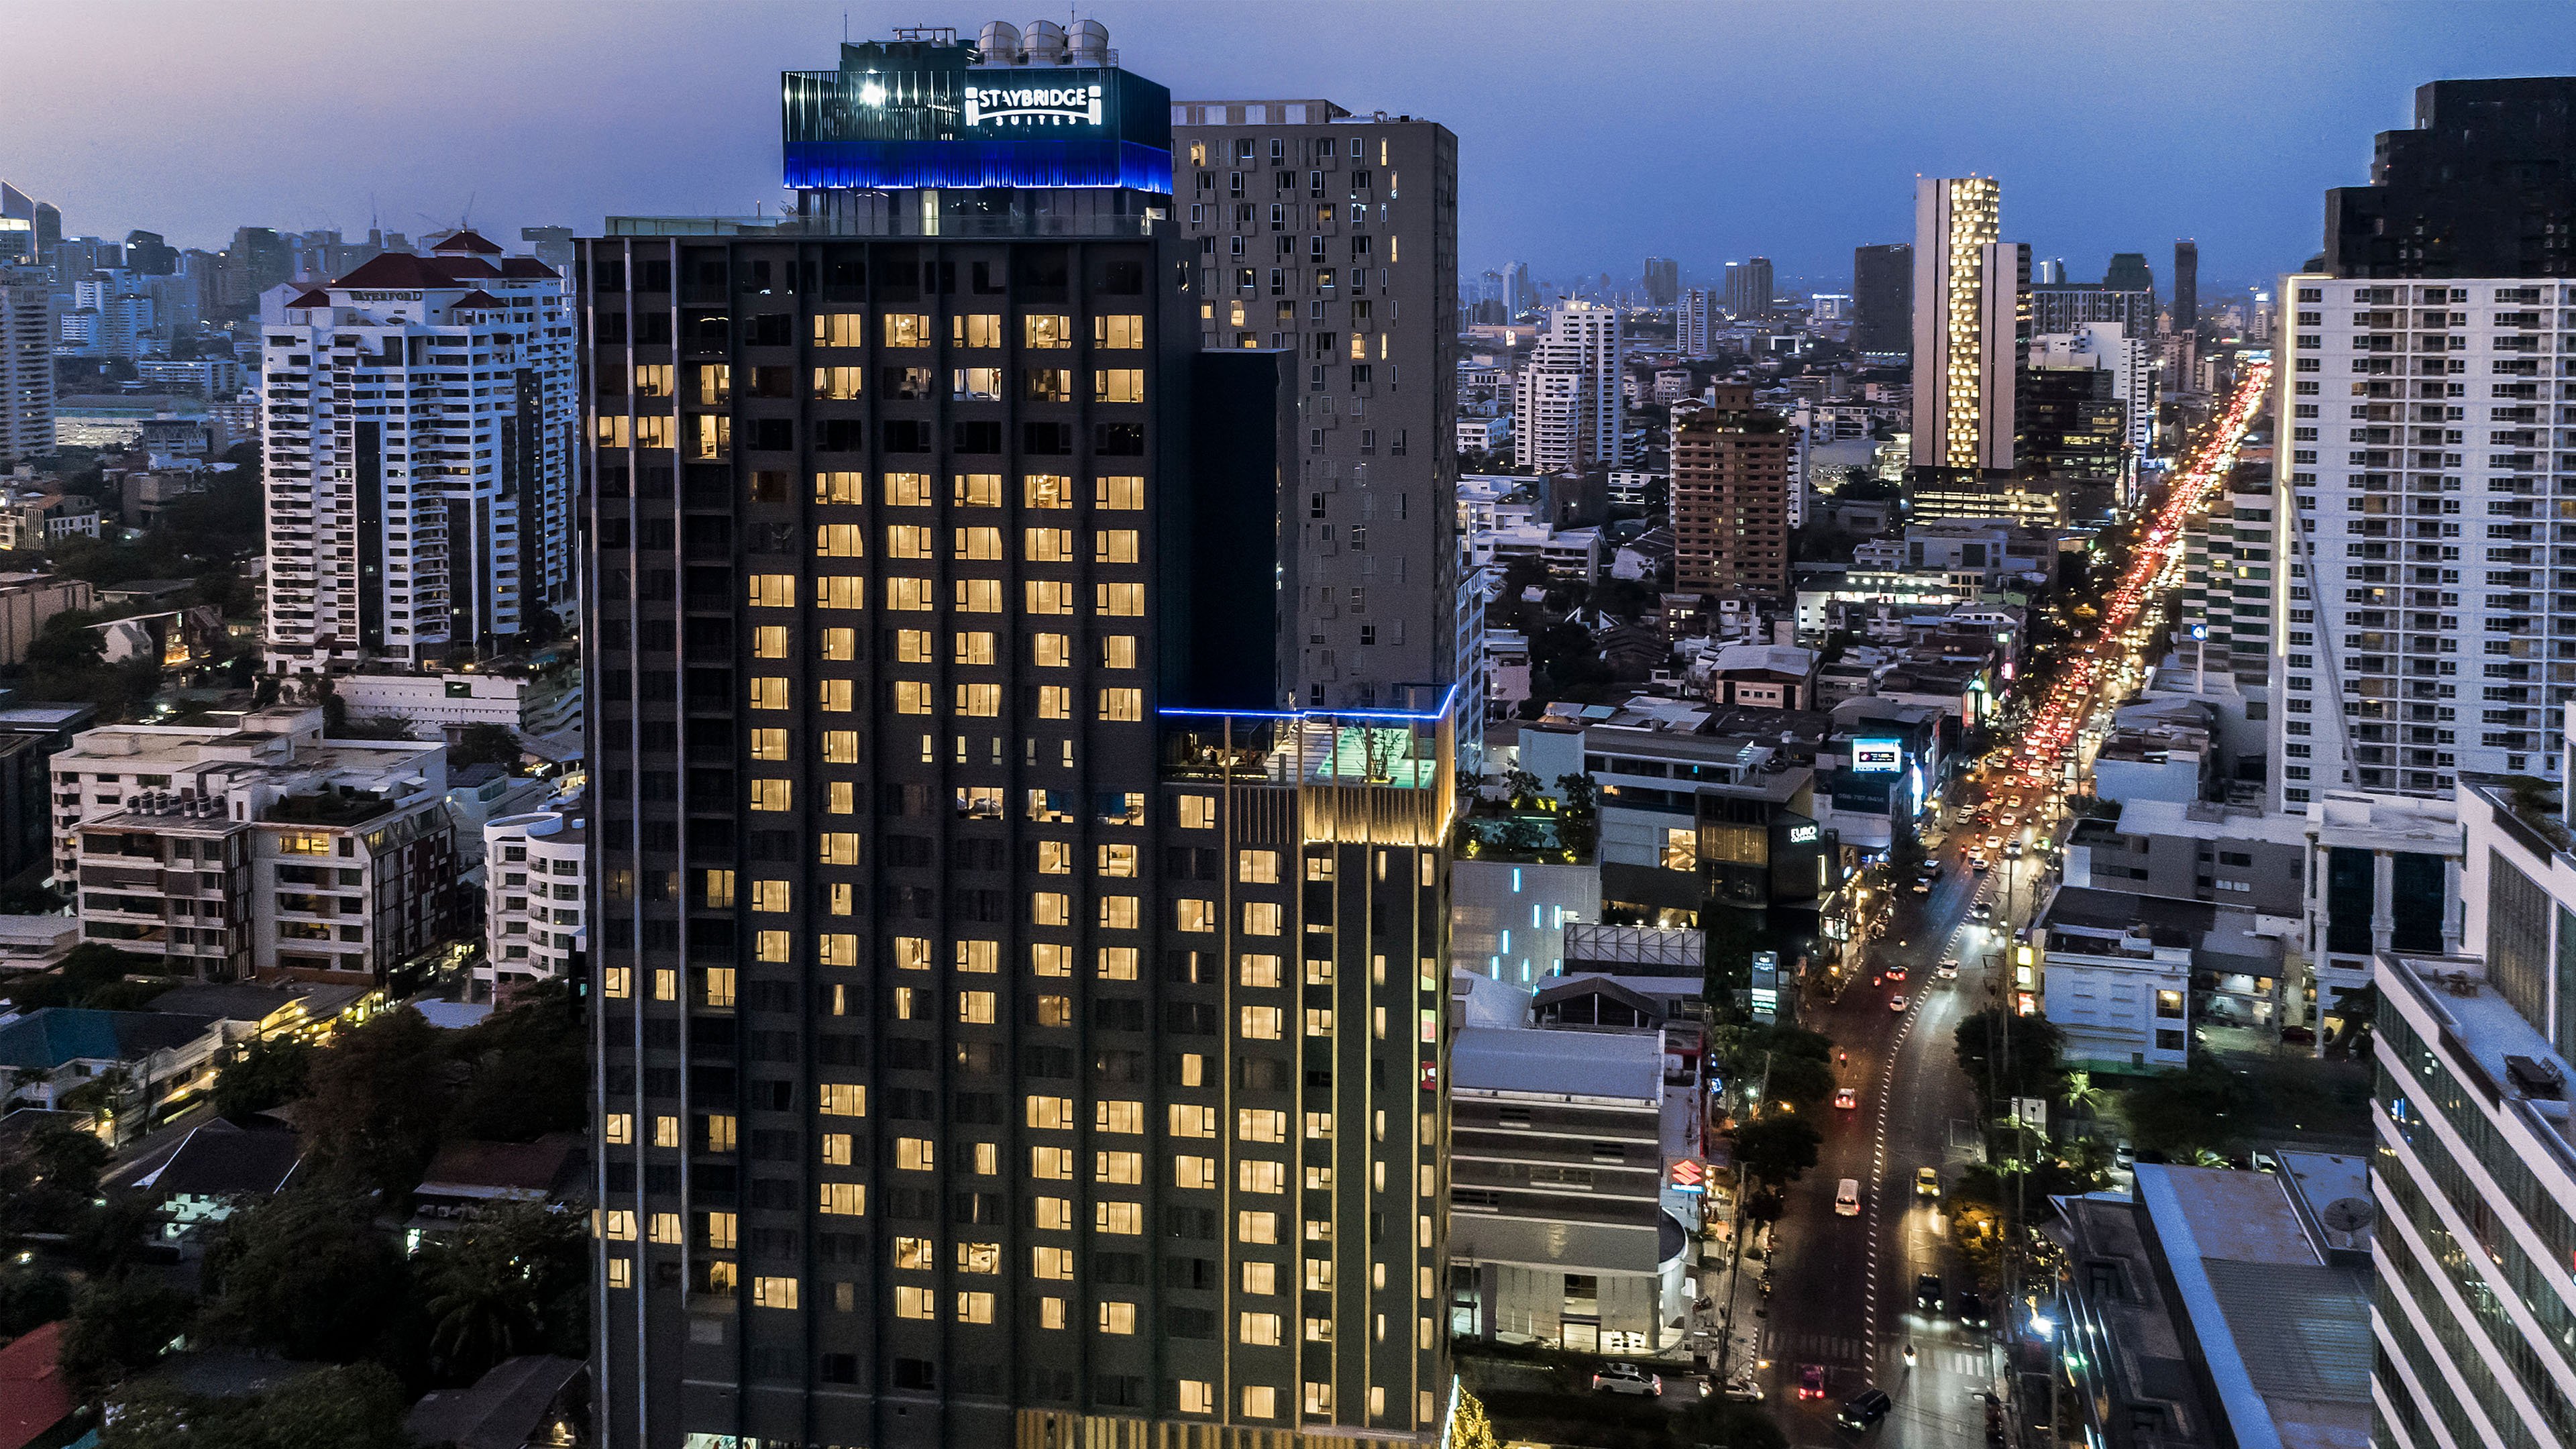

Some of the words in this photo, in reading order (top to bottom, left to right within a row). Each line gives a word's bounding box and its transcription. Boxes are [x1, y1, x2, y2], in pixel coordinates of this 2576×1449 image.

[979, 89, 1087, 107] STAYBRIDGE
[996, 115, 1077, 126] SUITES
[347, 291, 423, 301] WATERFORD
